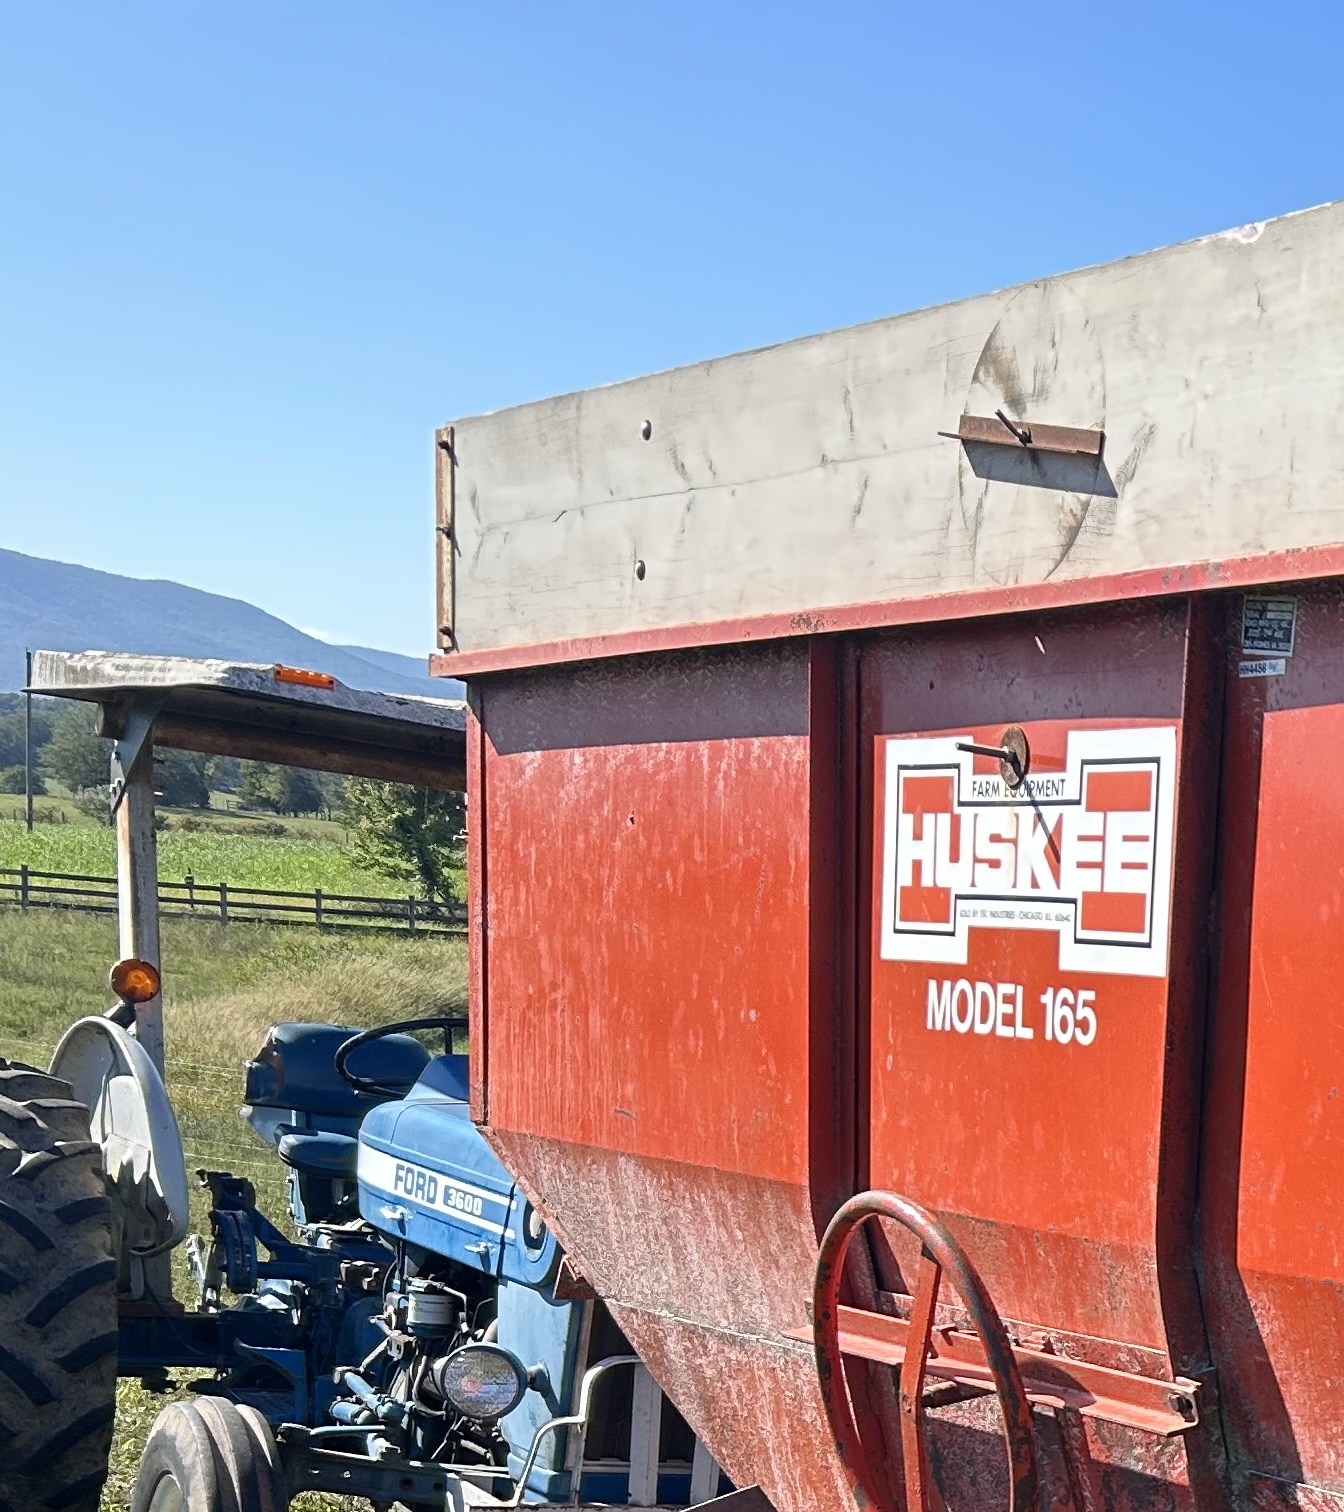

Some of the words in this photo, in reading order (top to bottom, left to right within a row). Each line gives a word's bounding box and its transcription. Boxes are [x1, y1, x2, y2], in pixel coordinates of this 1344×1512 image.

[972, 780, 1000, 798] FARM
[900, 810, 1149, 893] HUSKEE
[926, 978, 1034, 1040] MODEL
[1040, 986, 1097, 1046] 165
[394, 1163, 438, 1205] FORD
[447, 1188, 483, 1216] 3600
